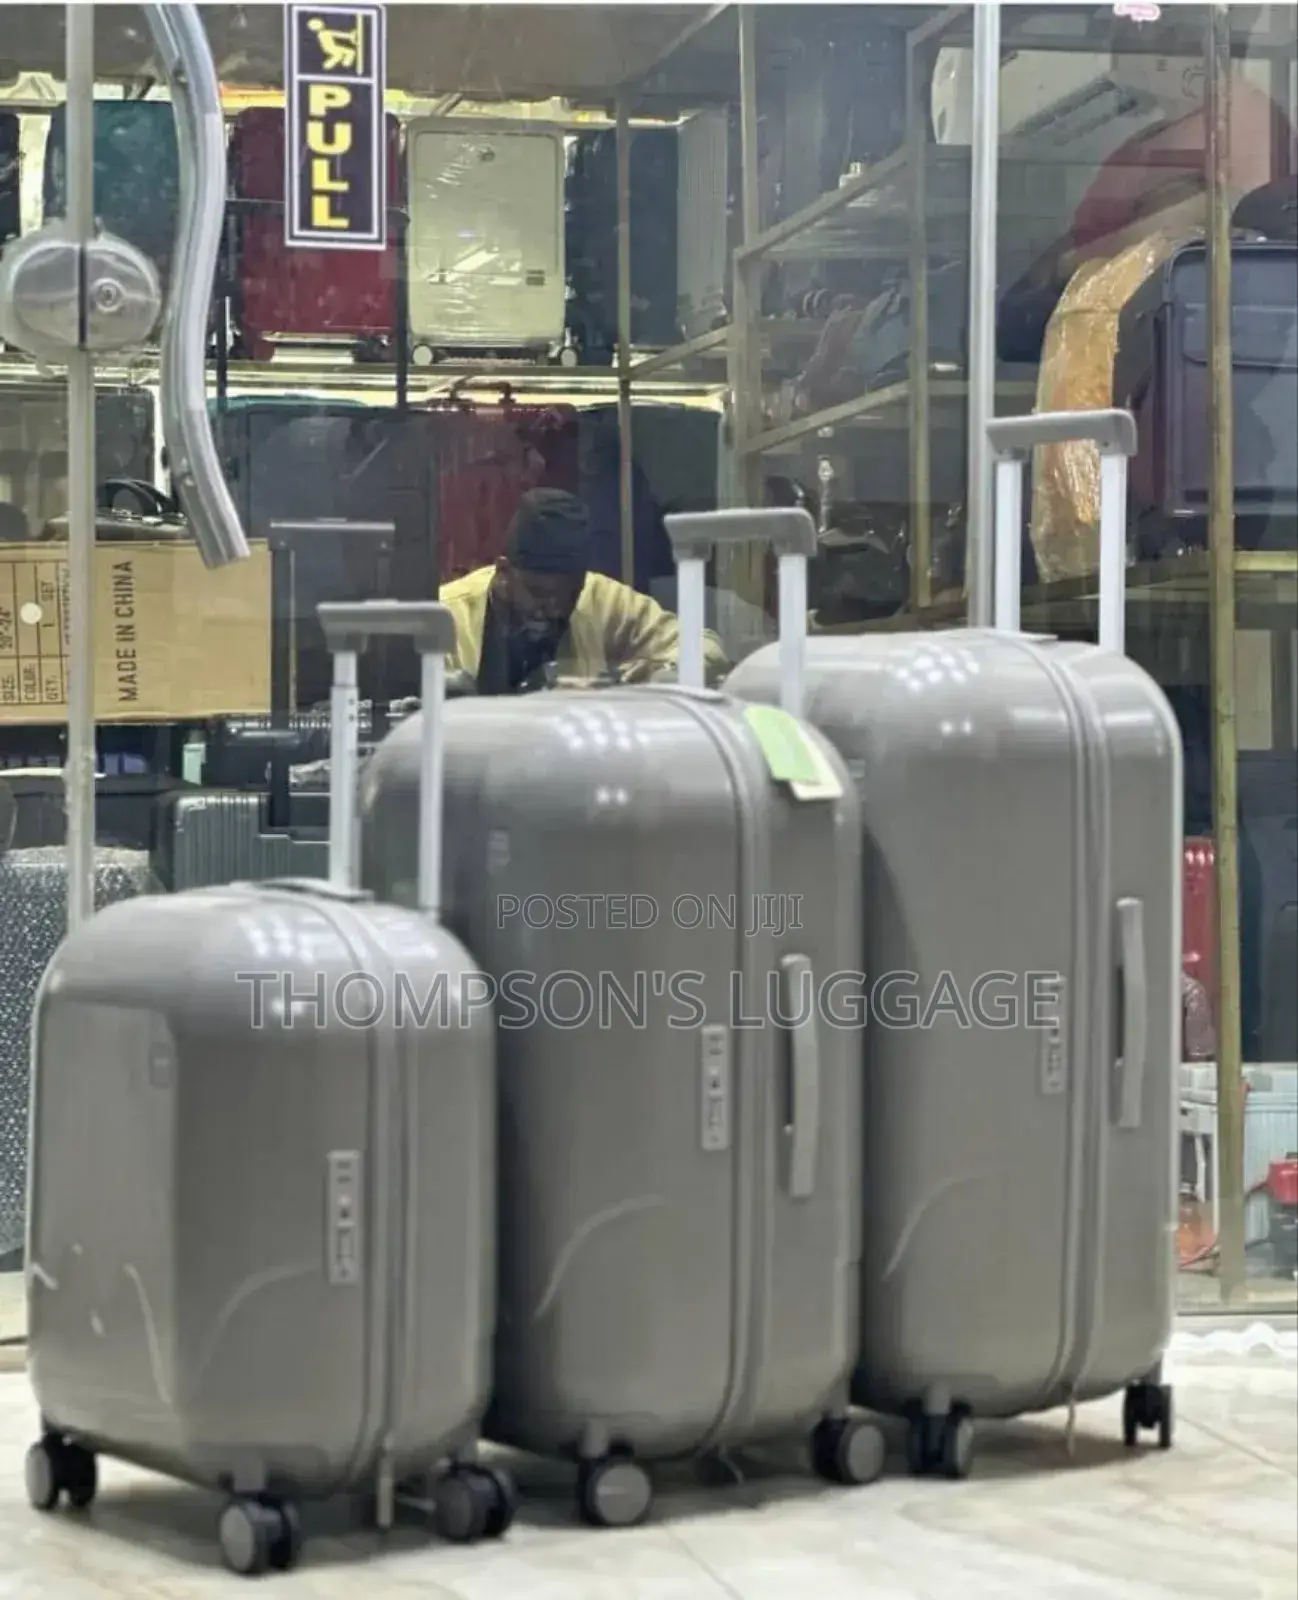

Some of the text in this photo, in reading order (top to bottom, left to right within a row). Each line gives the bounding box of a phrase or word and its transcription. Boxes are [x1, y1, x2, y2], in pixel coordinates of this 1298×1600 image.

[307, 84, 352, 228] PULL
[112, 560, 138, 702] MADE IN CHINA
